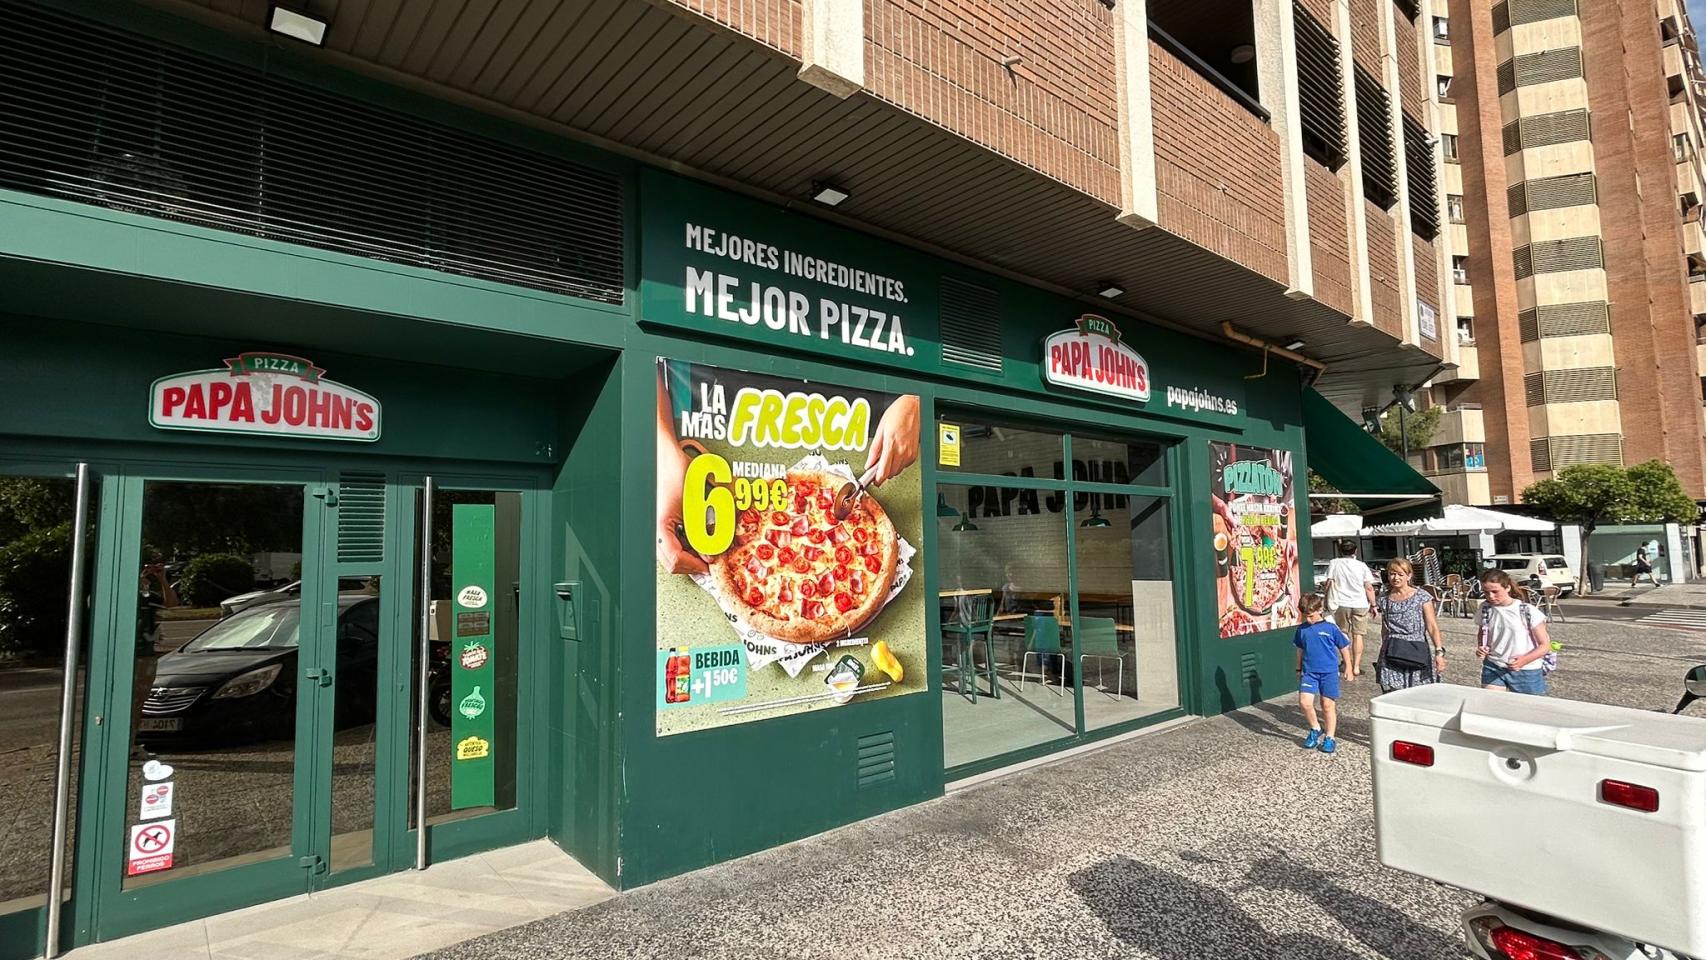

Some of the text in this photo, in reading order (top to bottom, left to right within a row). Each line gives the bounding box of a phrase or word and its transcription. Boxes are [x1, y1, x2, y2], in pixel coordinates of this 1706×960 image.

[685, 222, 909, 303] MEJORES INGREDIENTES.
[685, 266, 915, 357] MEJOR PIZZA.
[1088, 318, 1111, 335] PIZZA
[254, 356, 300, 374] PIZZA
[1051, 341, 1147, 392] PAPA JOHN'S
[162, 381, 375, 432] PAPA JOHN'S
[700, 382, 727, 415] LA
[729, 390, 869, 449] FRESCA
[1167, 384, 1239, 416] papajohns.es
[732, 461, 787, 479] MEDIANA
[682, 453, 737, 556] 6
[695, 649, 740, 669] BEBIDA
